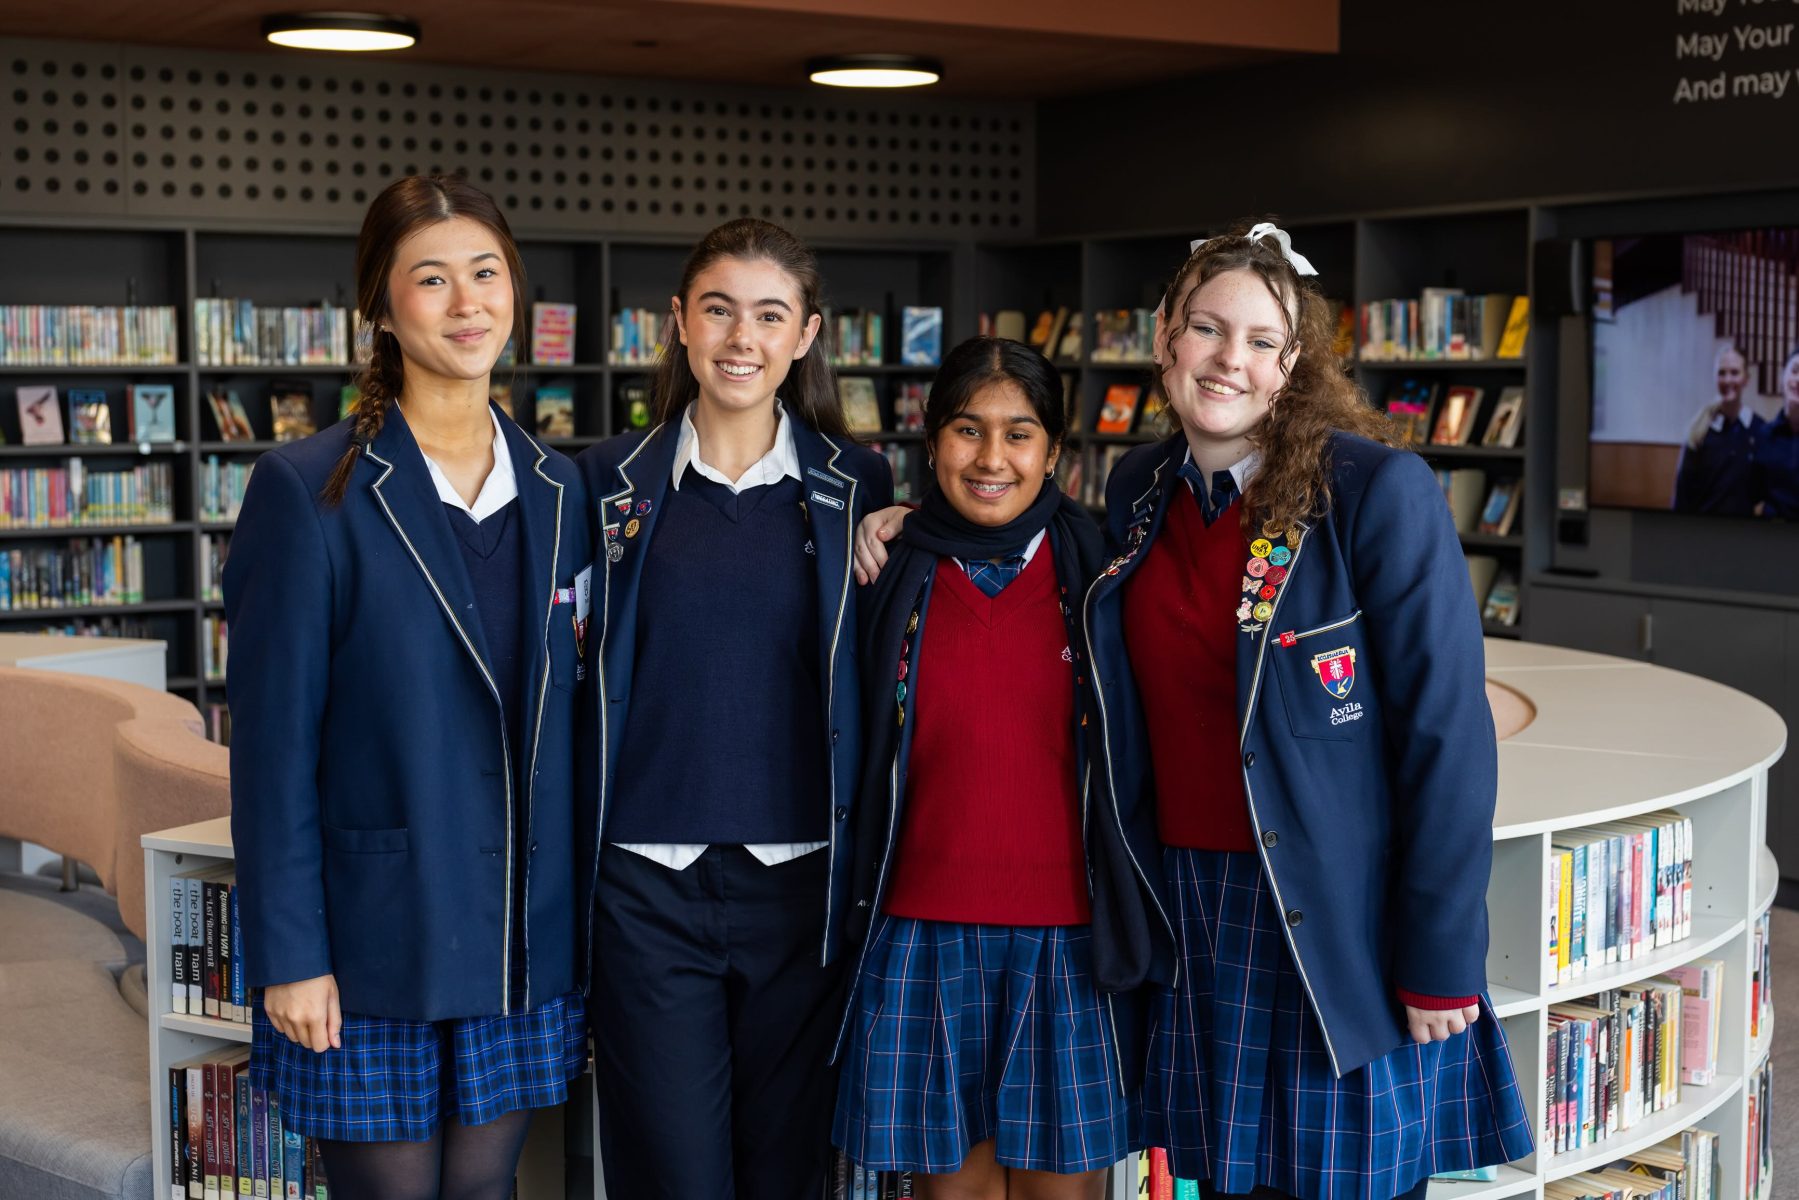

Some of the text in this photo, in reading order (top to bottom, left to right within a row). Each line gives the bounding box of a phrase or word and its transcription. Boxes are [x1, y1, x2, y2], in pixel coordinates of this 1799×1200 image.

[1677, 0, 1727, 16] May
[1676, 24, 1794, 61] May Your
[1673, 70, 1790, 104] And may
[1330, 702, 1363, 719] Avila
[1331, 711, 1364, 726] College
[173, 889, 182, 938] the boat
[190, 890, 199, 939] the boat
[206, 899, 214, 916] LAST
[219, 890, 228, 924] RUNNING
[206, 918, 214, 967] BLOODCARVER
[220, 933, 229, 957] IVAN
[233, 926, 241, 957] Escaped
[175, 952, 184, 980] nam
[191, 953, 200, 981] nam
[1572, 1043, 1580, 1071] Legacy
[270, 1117, 279, 1142] RIVALS
[206, 1140, 215, 1163] HOUSE
[222, 1141, 231, 1164] HOUSE
[256, 1159, 264, 1180] TUNNE
[271, 1159, 281, 1178] CITY
